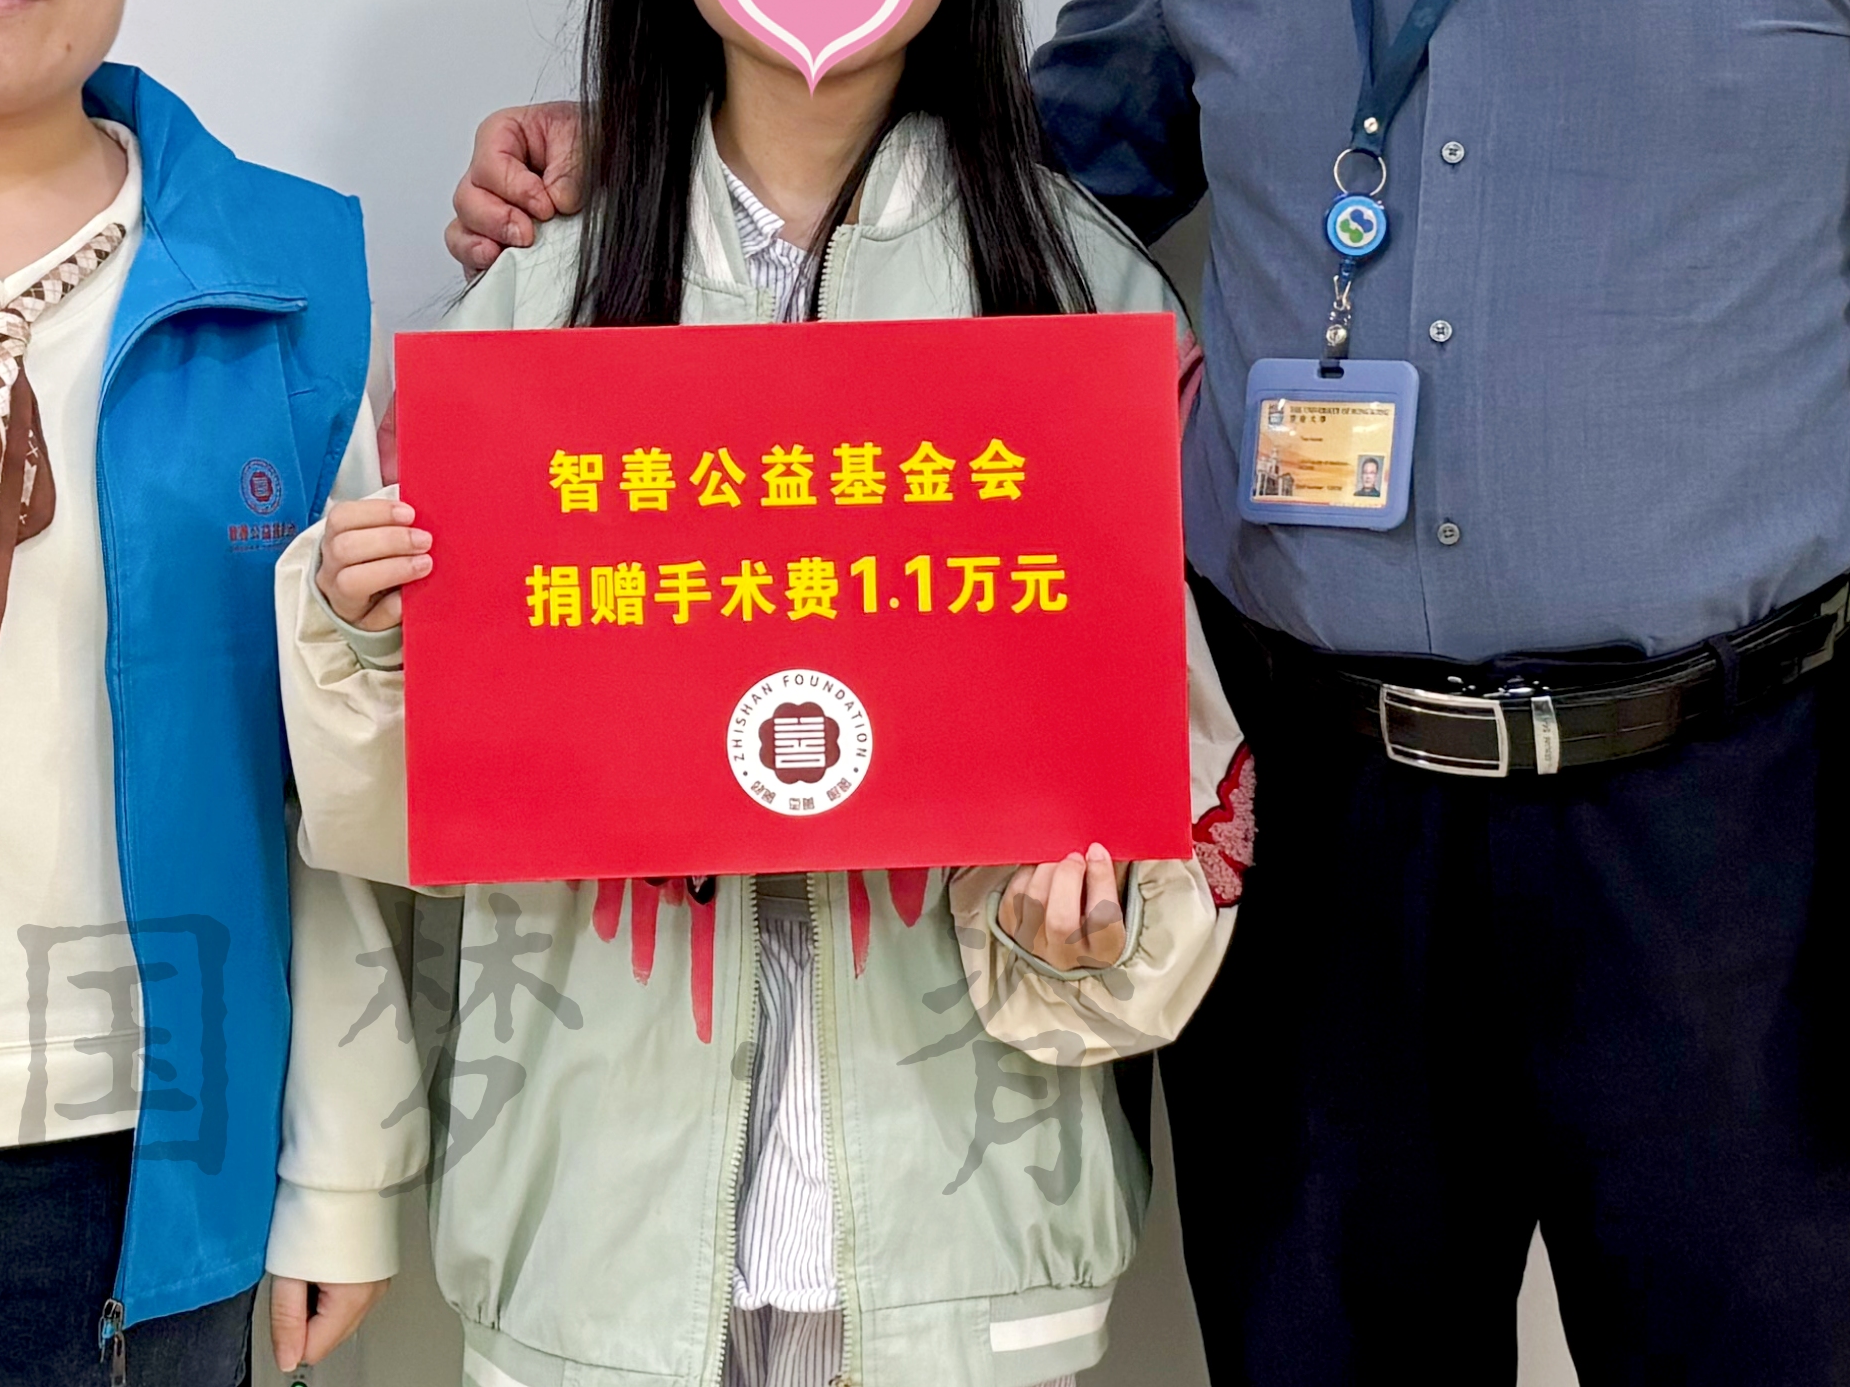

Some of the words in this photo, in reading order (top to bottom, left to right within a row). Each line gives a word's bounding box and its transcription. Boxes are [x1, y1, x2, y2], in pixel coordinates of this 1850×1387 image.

[550, 439, 1025, 512] 智善公益基金会
[526, 555, 1067, 626] 捐赠手术费1.1万元
[732, 682, 774, 762] ZHISHAN
[782, 673, 868, 759] FOUNDATION
